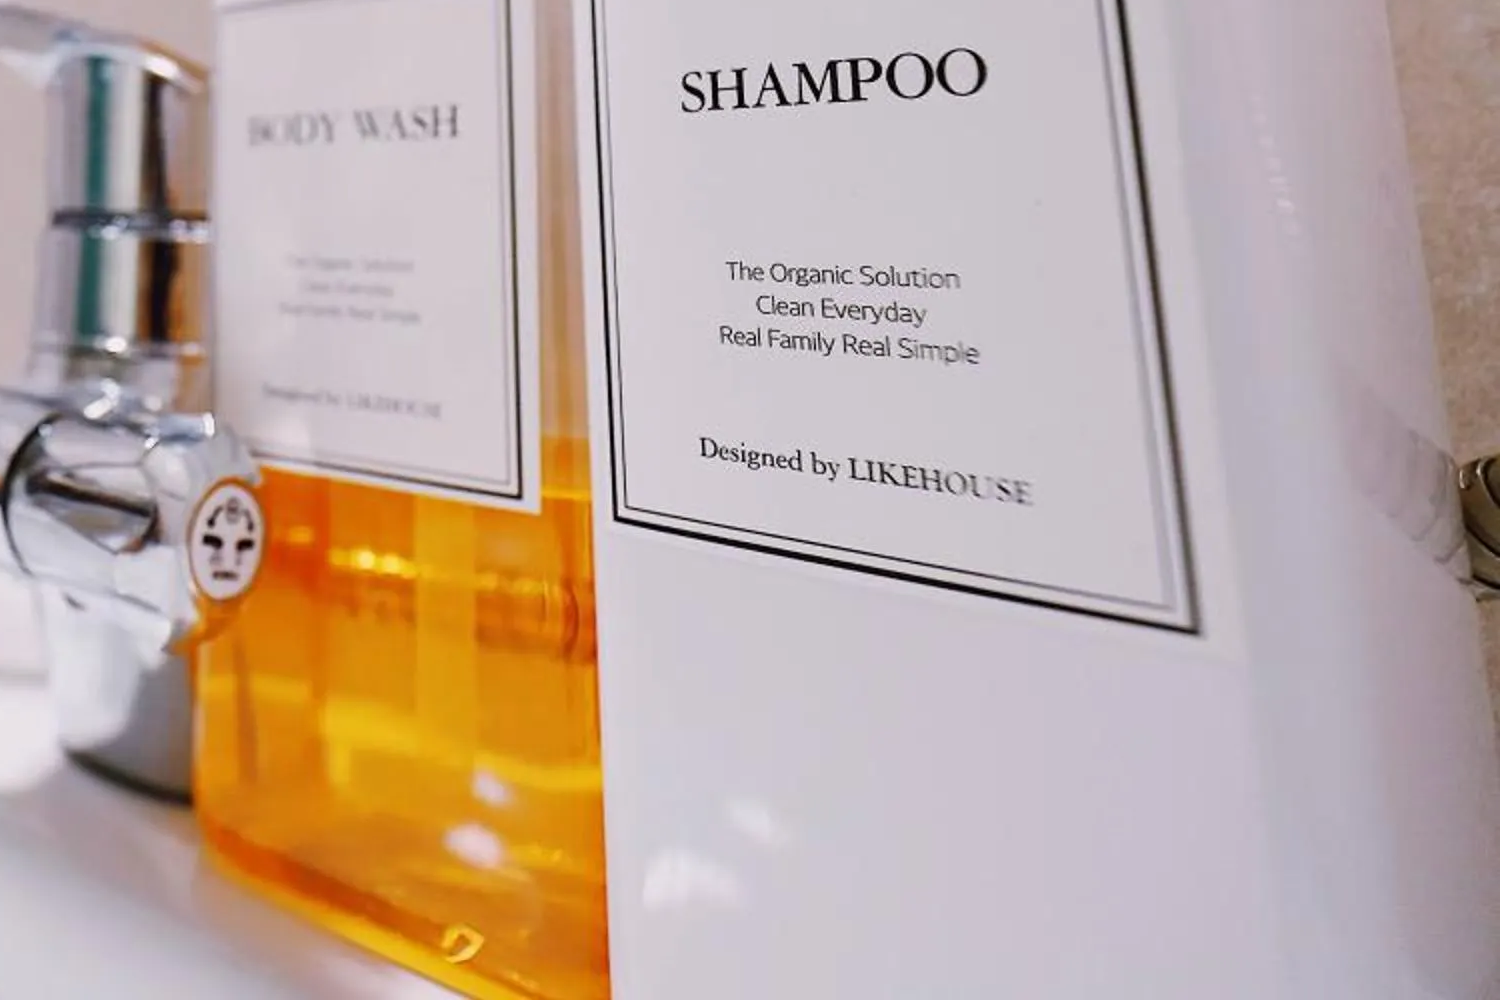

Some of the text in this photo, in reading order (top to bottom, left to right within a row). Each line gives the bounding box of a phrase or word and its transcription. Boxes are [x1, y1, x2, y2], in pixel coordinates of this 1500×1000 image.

[680, 47, 988, 114] SHAMPOO
[247, 104, 460, 146] BODY WASH
[725, 260, 962, 290] The Organic Solution
[755, 294, 928, 329] Clean Everyday
[719, 324, 981, 367] Real Family Real Simple
[698, 436, 1036, 507] Designed by LIKEHOUSE
